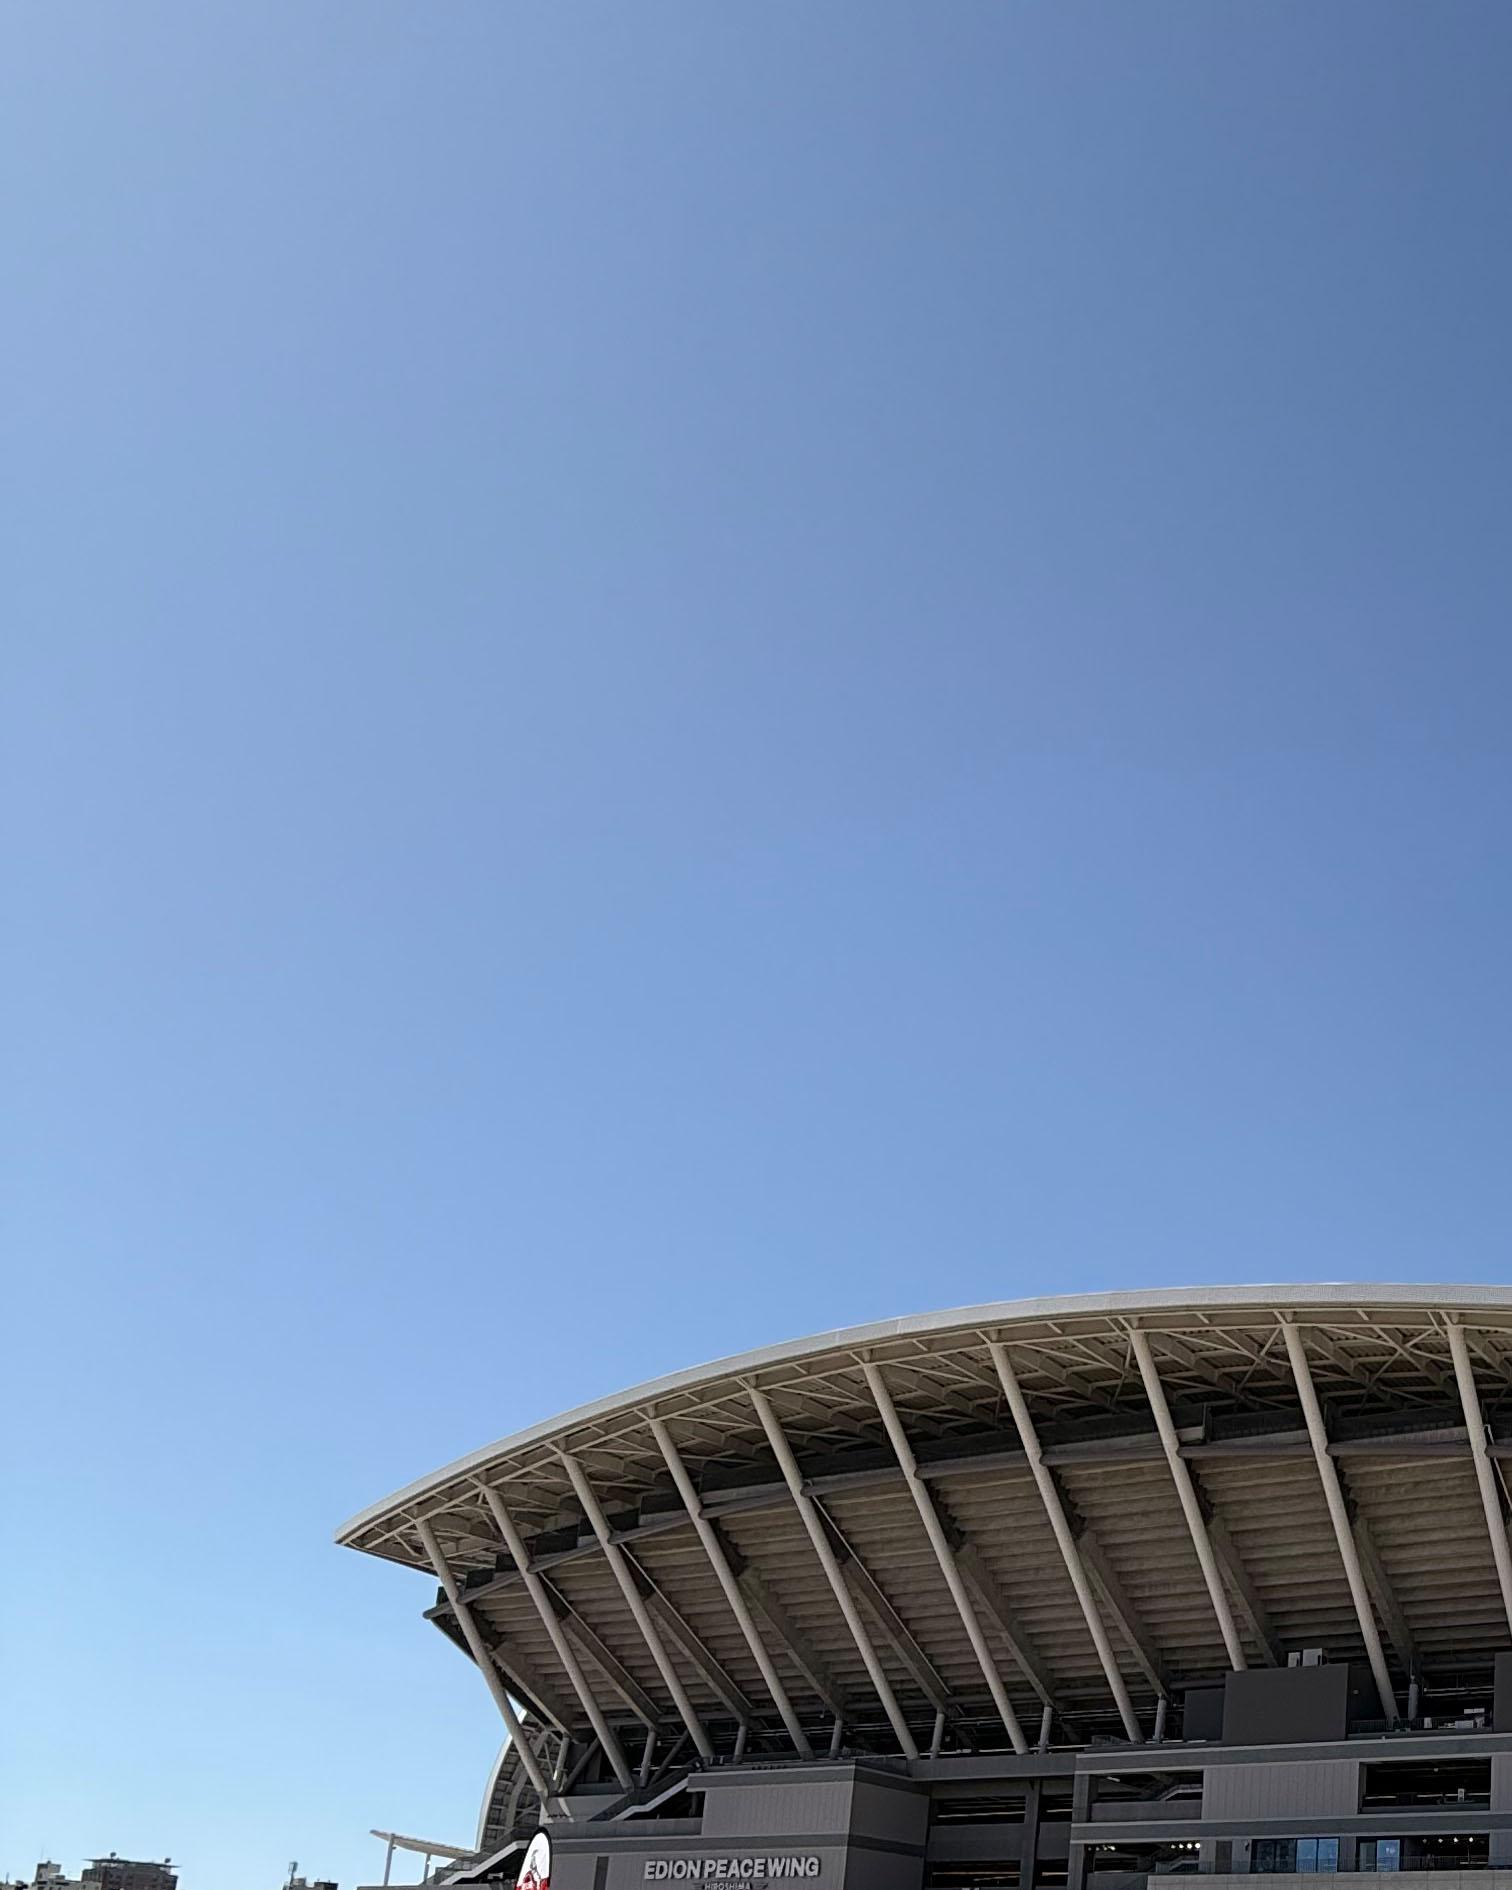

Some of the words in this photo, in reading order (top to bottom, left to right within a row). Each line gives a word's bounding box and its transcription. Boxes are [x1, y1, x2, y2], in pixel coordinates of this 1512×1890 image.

[644, 1860, 701, 1880] EDION
[703, 1858, 766, 1879] PEACE
[767, 1857, 820, 1877] WING
